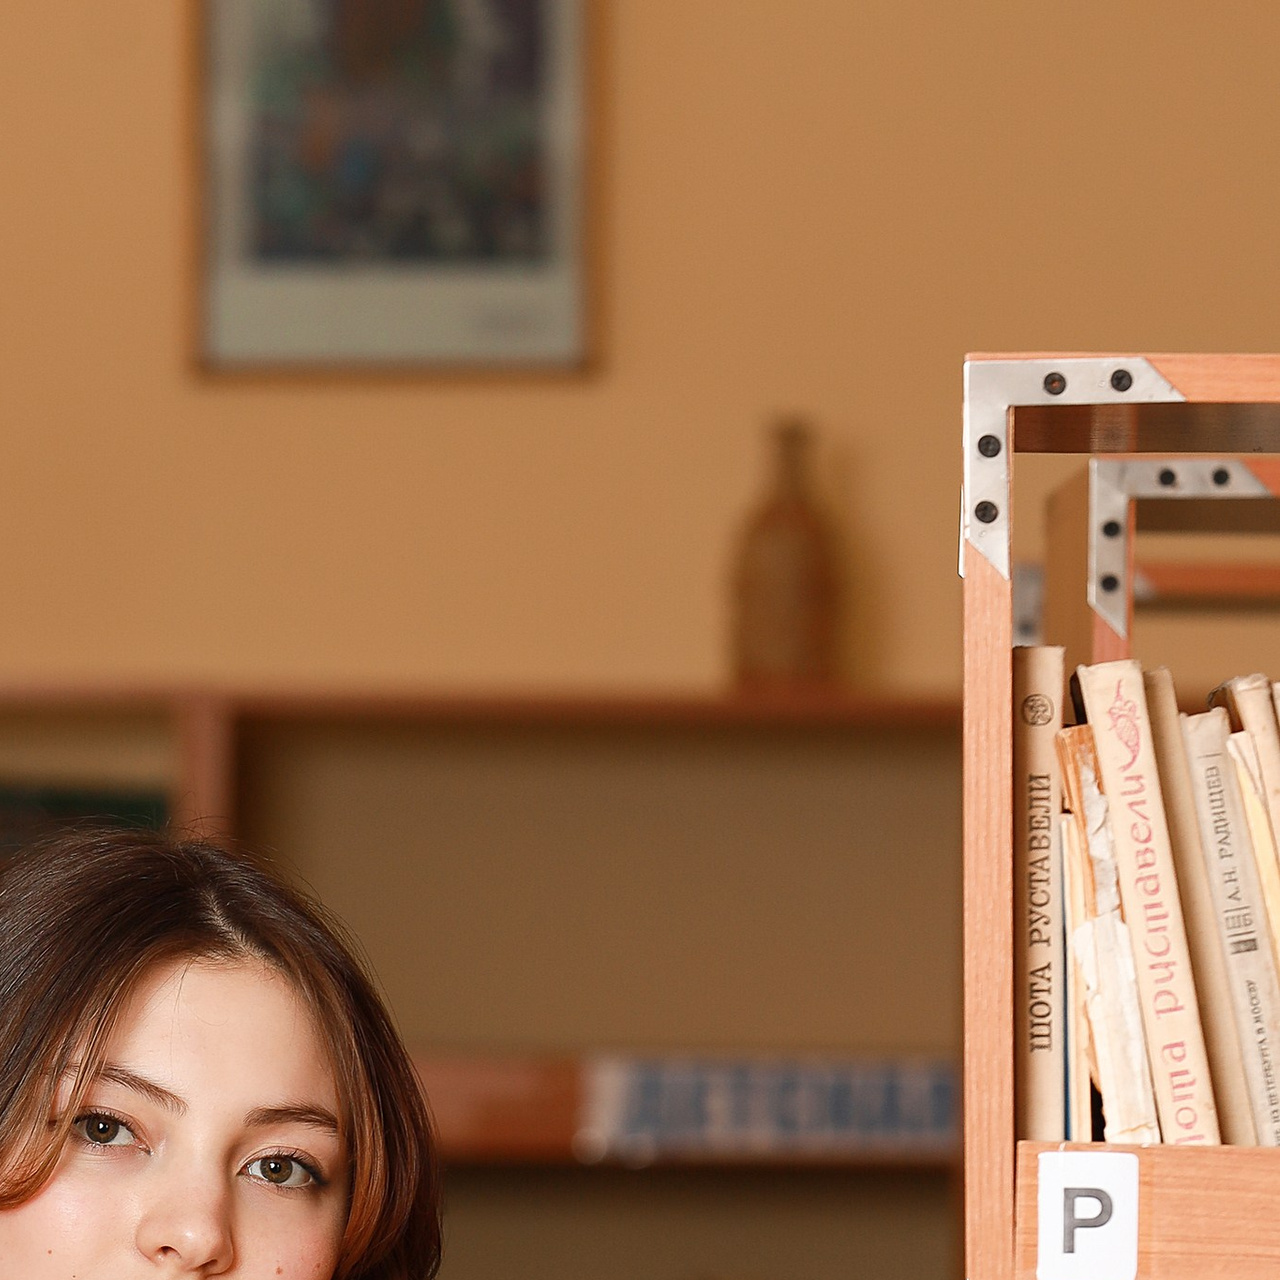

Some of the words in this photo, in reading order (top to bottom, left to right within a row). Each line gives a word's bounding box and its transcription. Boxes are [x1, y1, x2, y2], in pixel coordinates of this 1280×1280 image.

[1204, 765, 1235, 860] РАДИЩЕВ
[1029, 772, 1052, 948] РУСТАВЕЛИ
[1029, 961, 1052, 1053] ШОТА
[1062, 1186, 1114, 1254] Р
